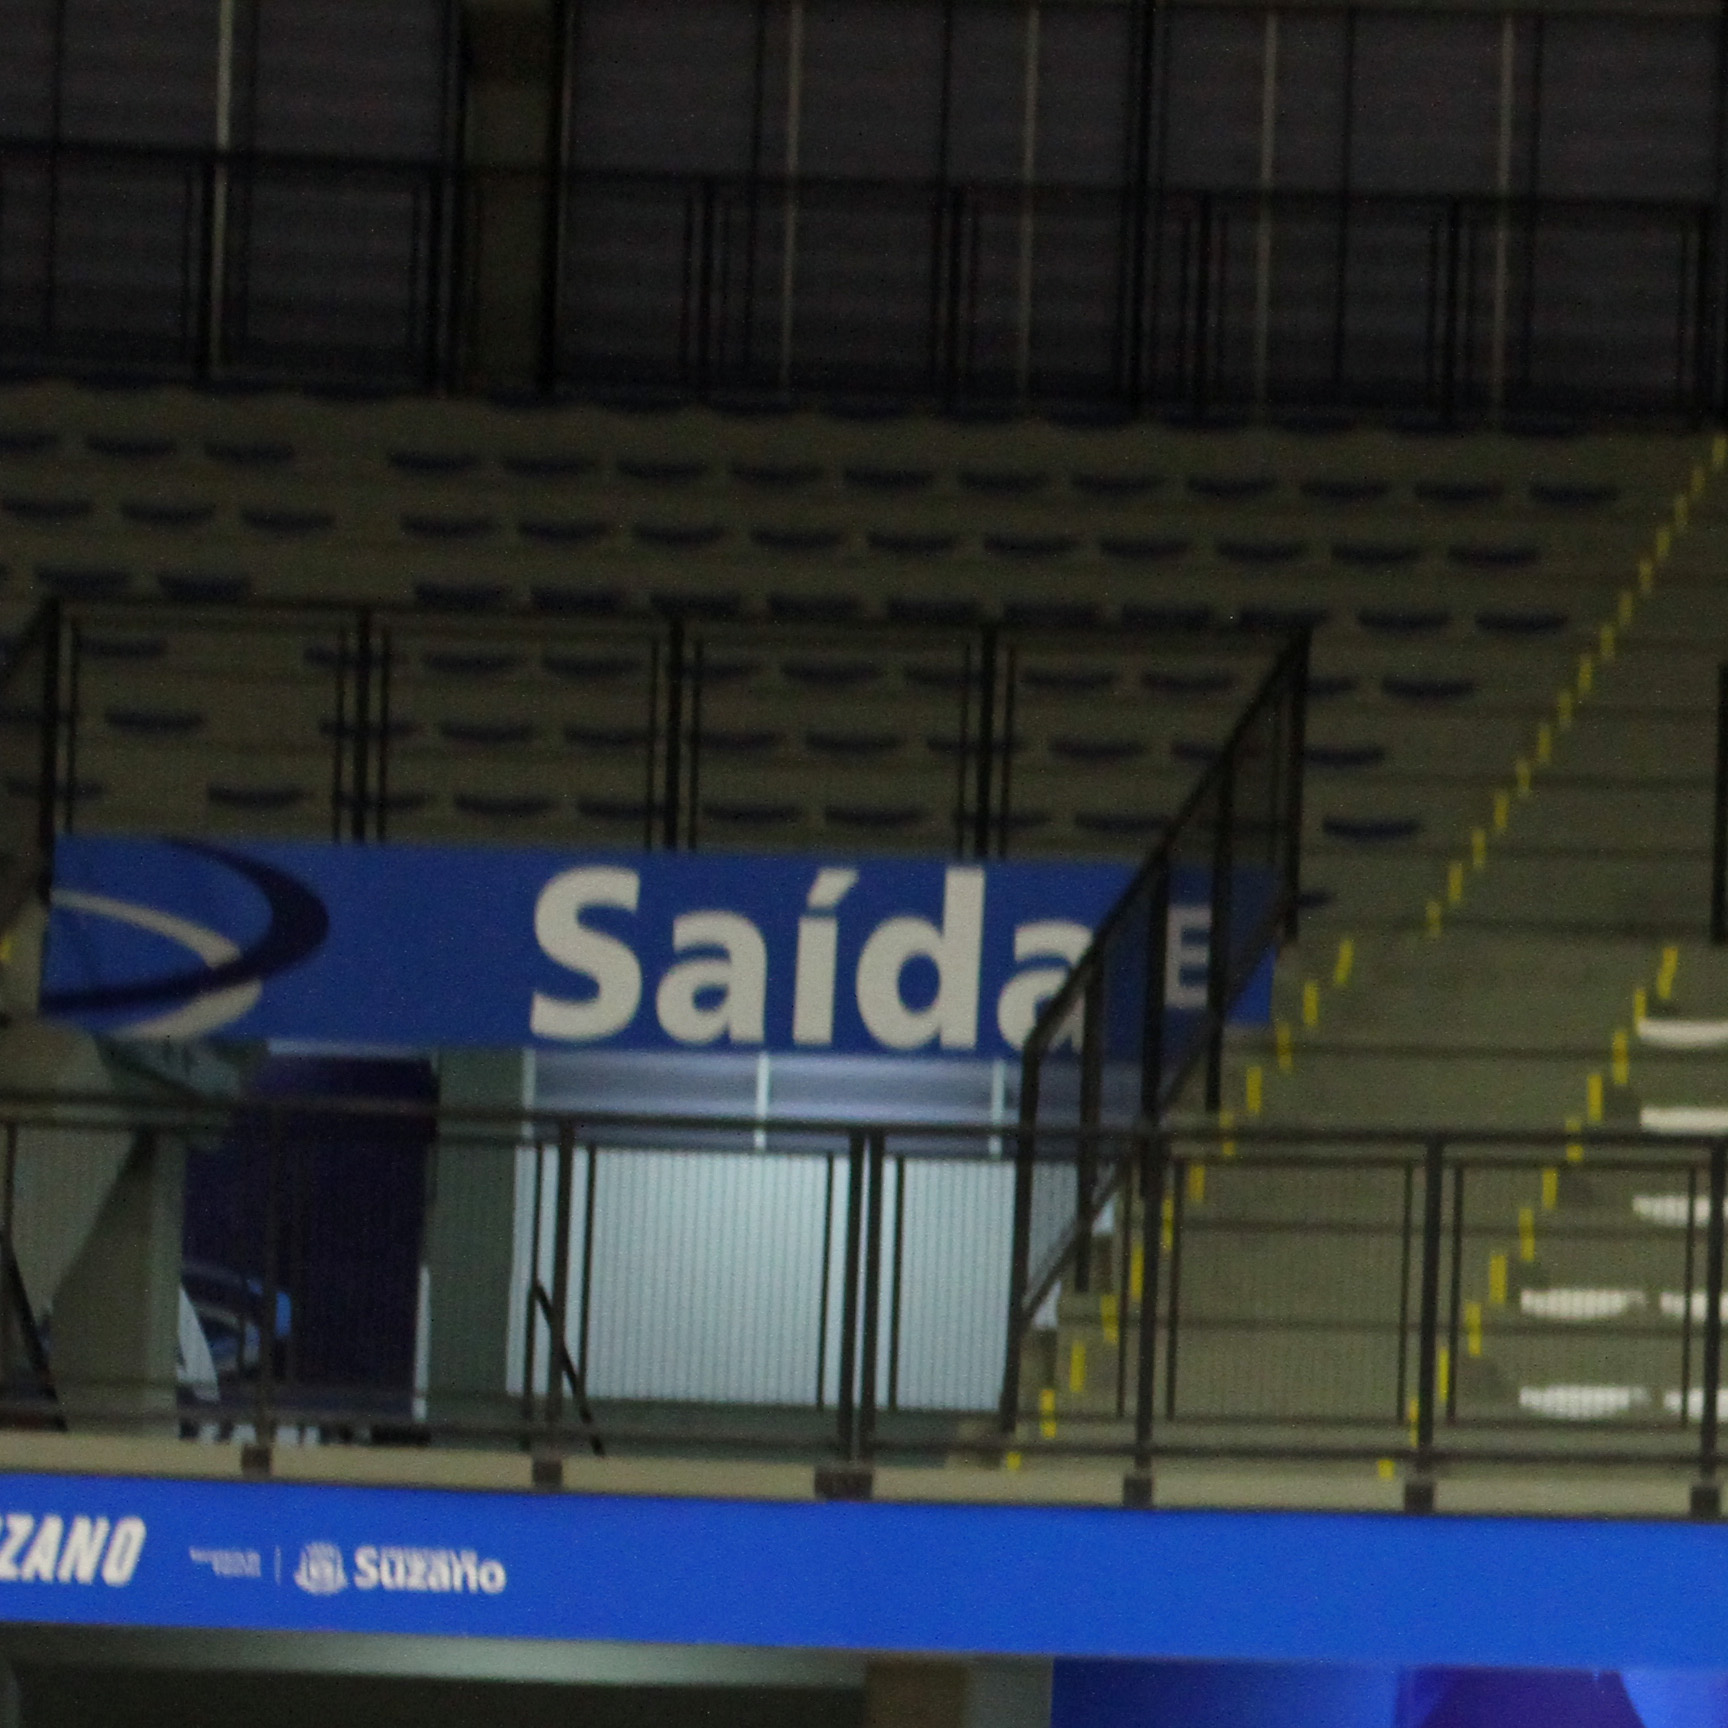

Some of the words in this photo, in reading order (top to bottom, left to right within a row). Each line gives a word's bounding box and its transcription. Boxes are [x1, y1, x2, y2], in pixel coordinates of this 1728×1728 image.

[530, 864, 1094, 1052] Saída
[0, 1512, 147, 1588] ZANO
[354, 1545, 506, 1594] Suzano
